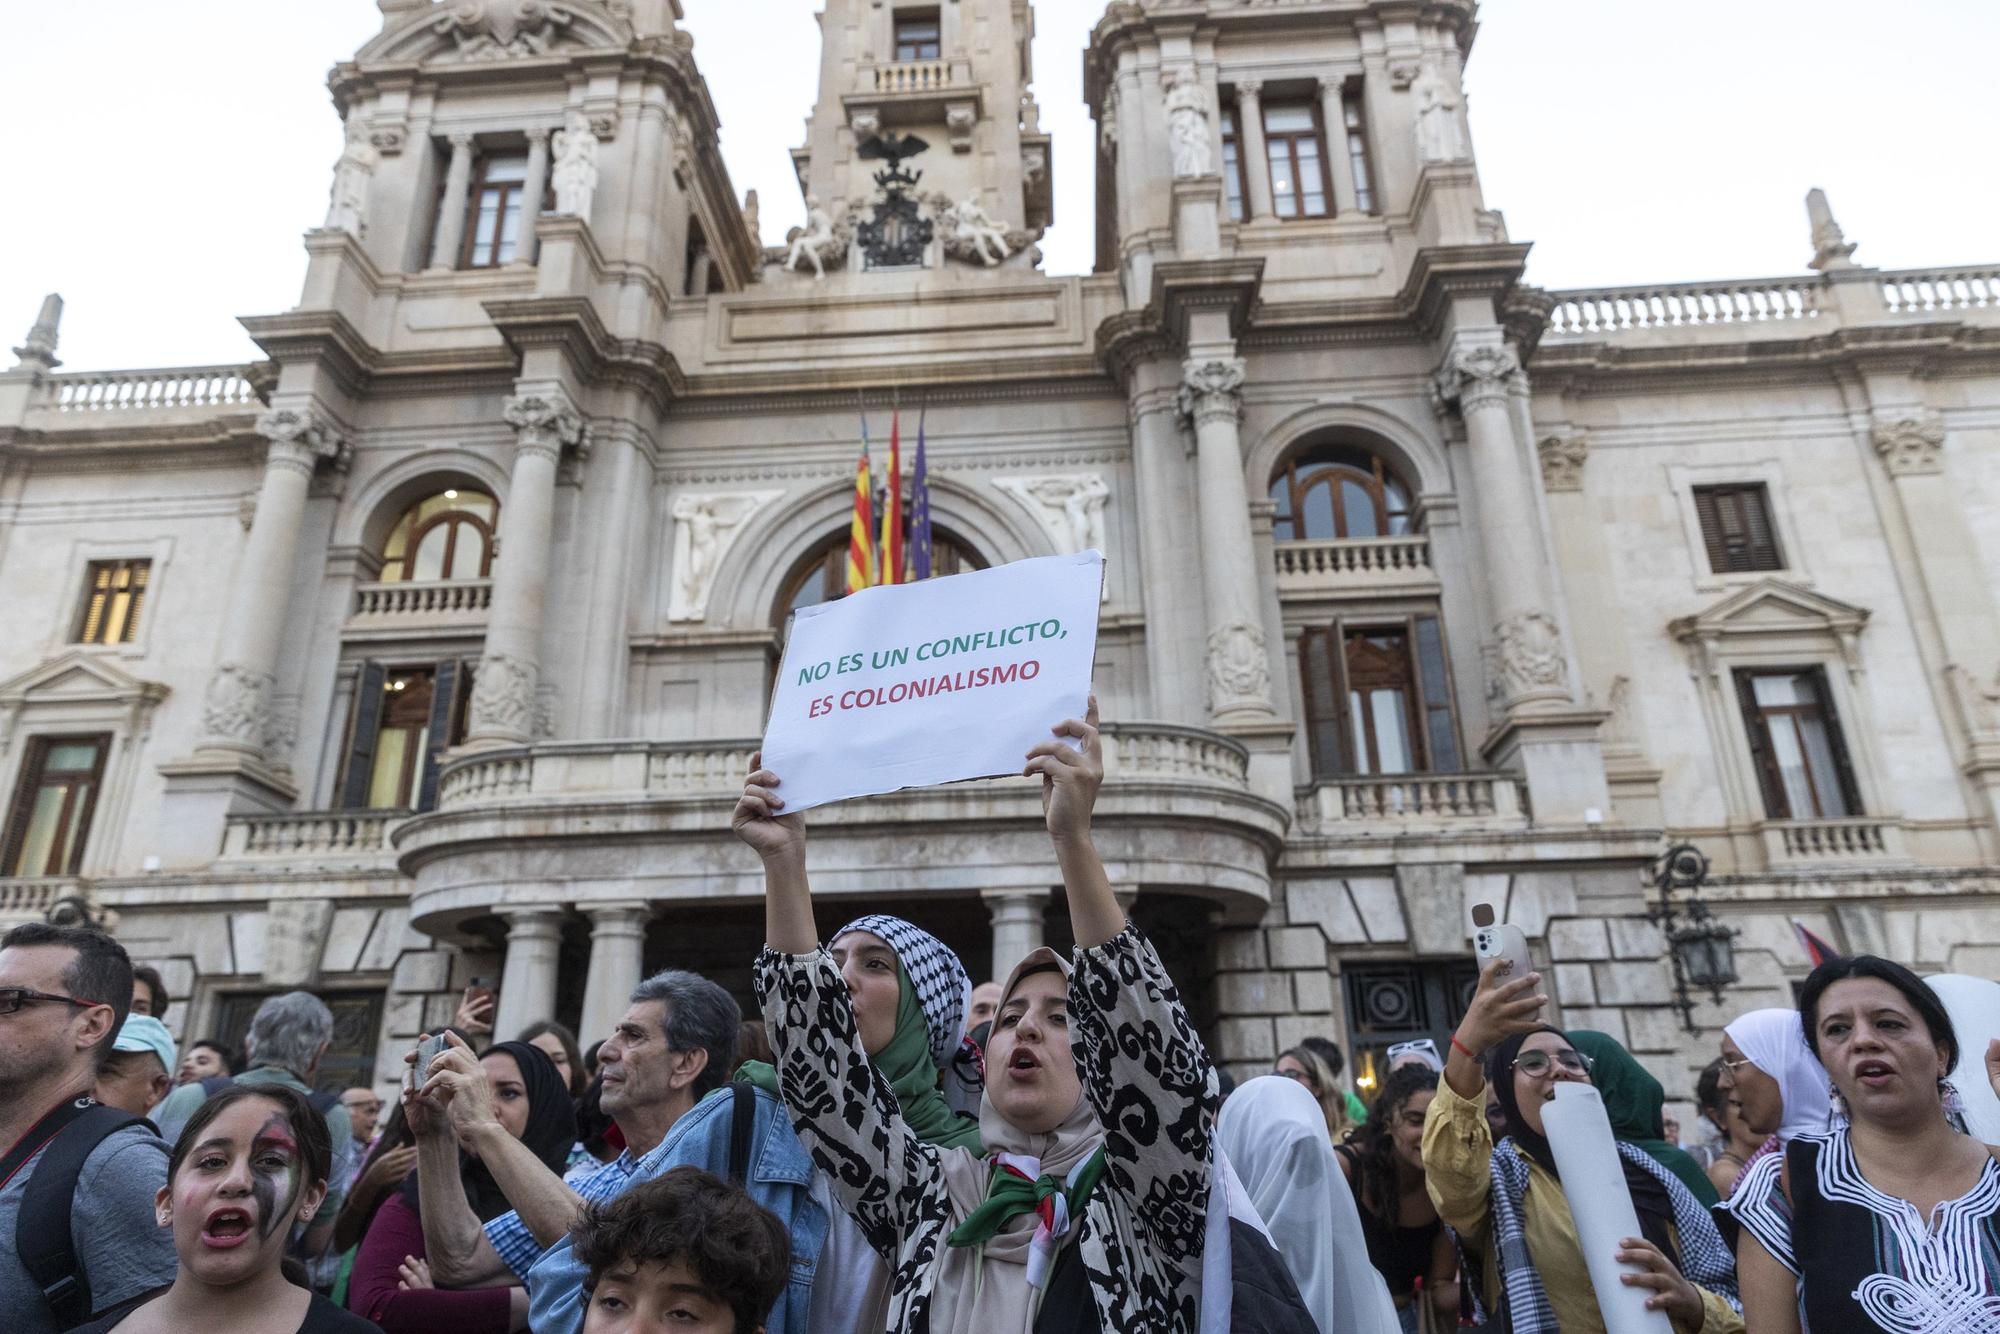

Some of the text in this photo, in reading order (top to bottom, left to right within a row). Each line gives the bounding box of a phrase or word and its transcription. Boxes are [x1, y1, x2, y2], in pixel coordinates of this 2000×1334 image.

[798, 618, 1068, 686] NO ES UN CONFLICTO,
[808, 660, 1040, 719] ES COLONIALISMO
